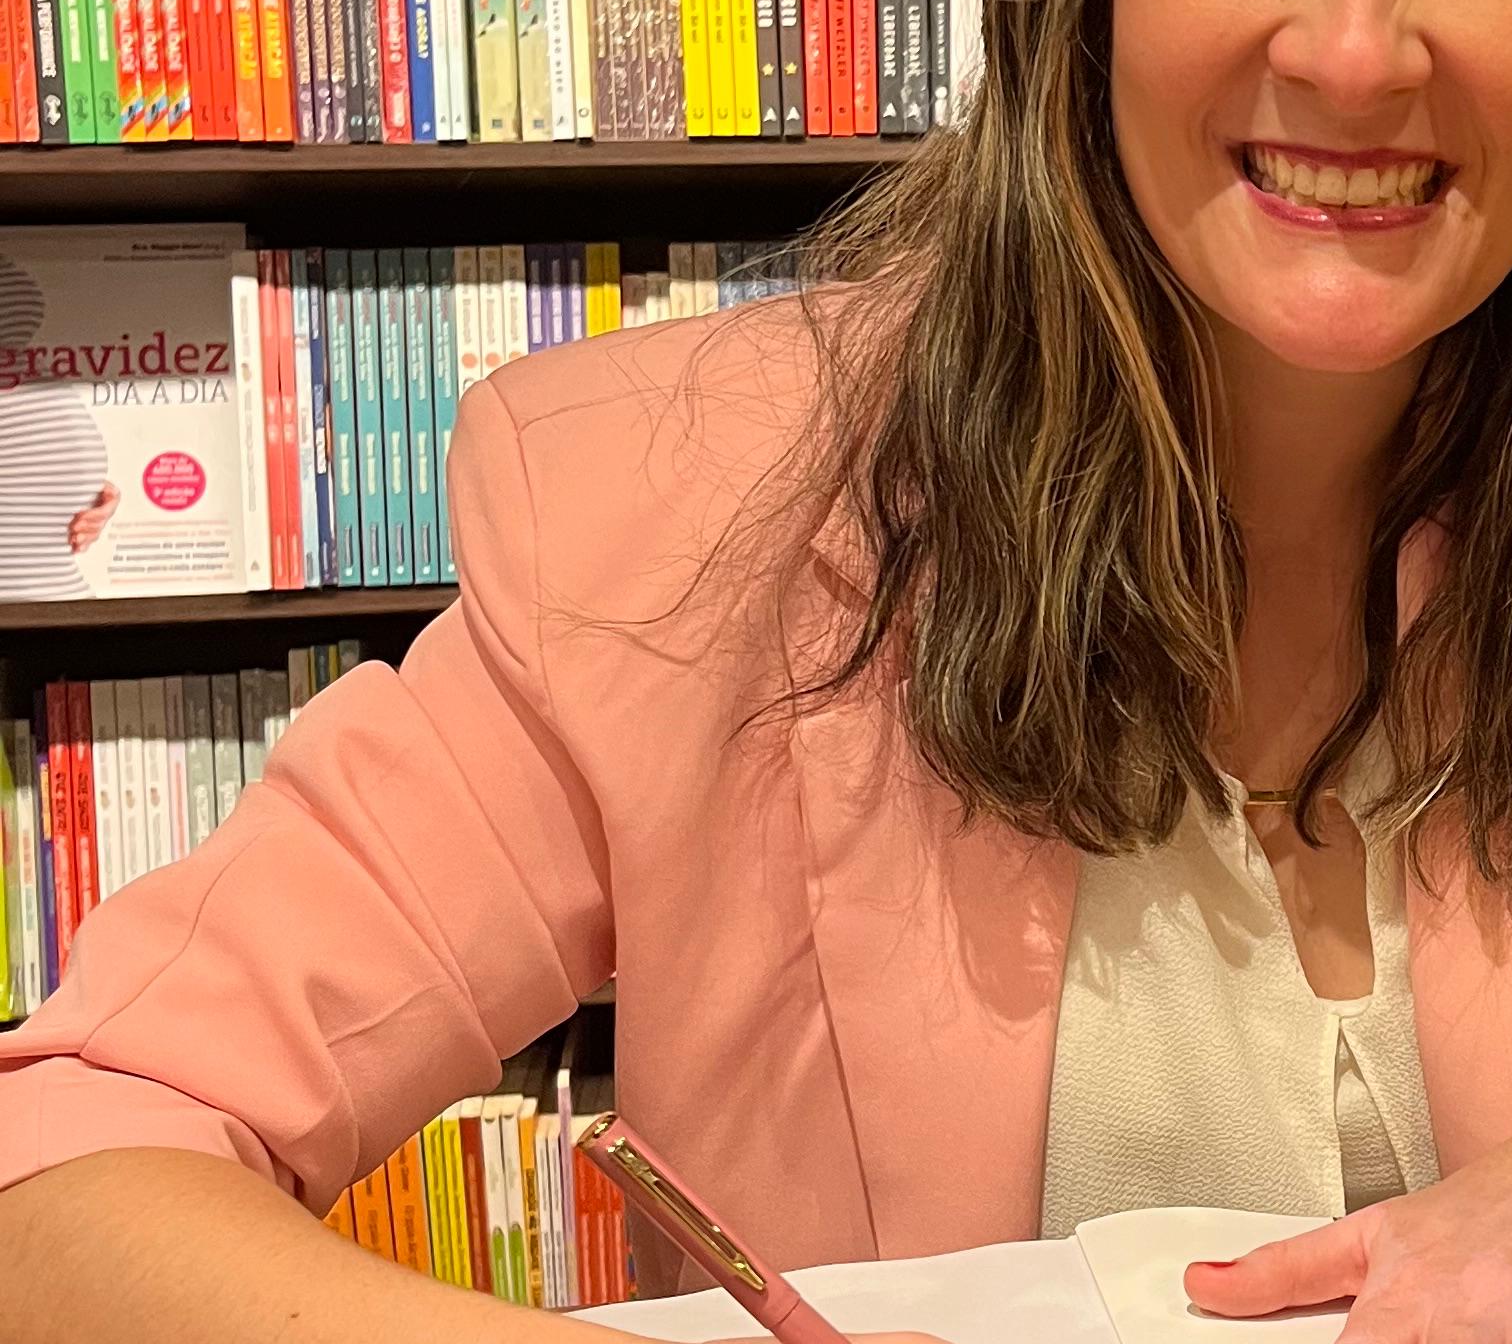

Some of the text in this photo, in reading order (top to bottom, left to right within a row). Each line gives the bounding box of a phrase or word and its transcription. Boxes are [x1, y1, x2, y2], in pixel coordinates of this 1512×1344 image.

[882, 6, 896, 77] LIBERDADE
[0, 332, 231, 391] gravidez
[92, 378, 230, 407] DIA A DIA
